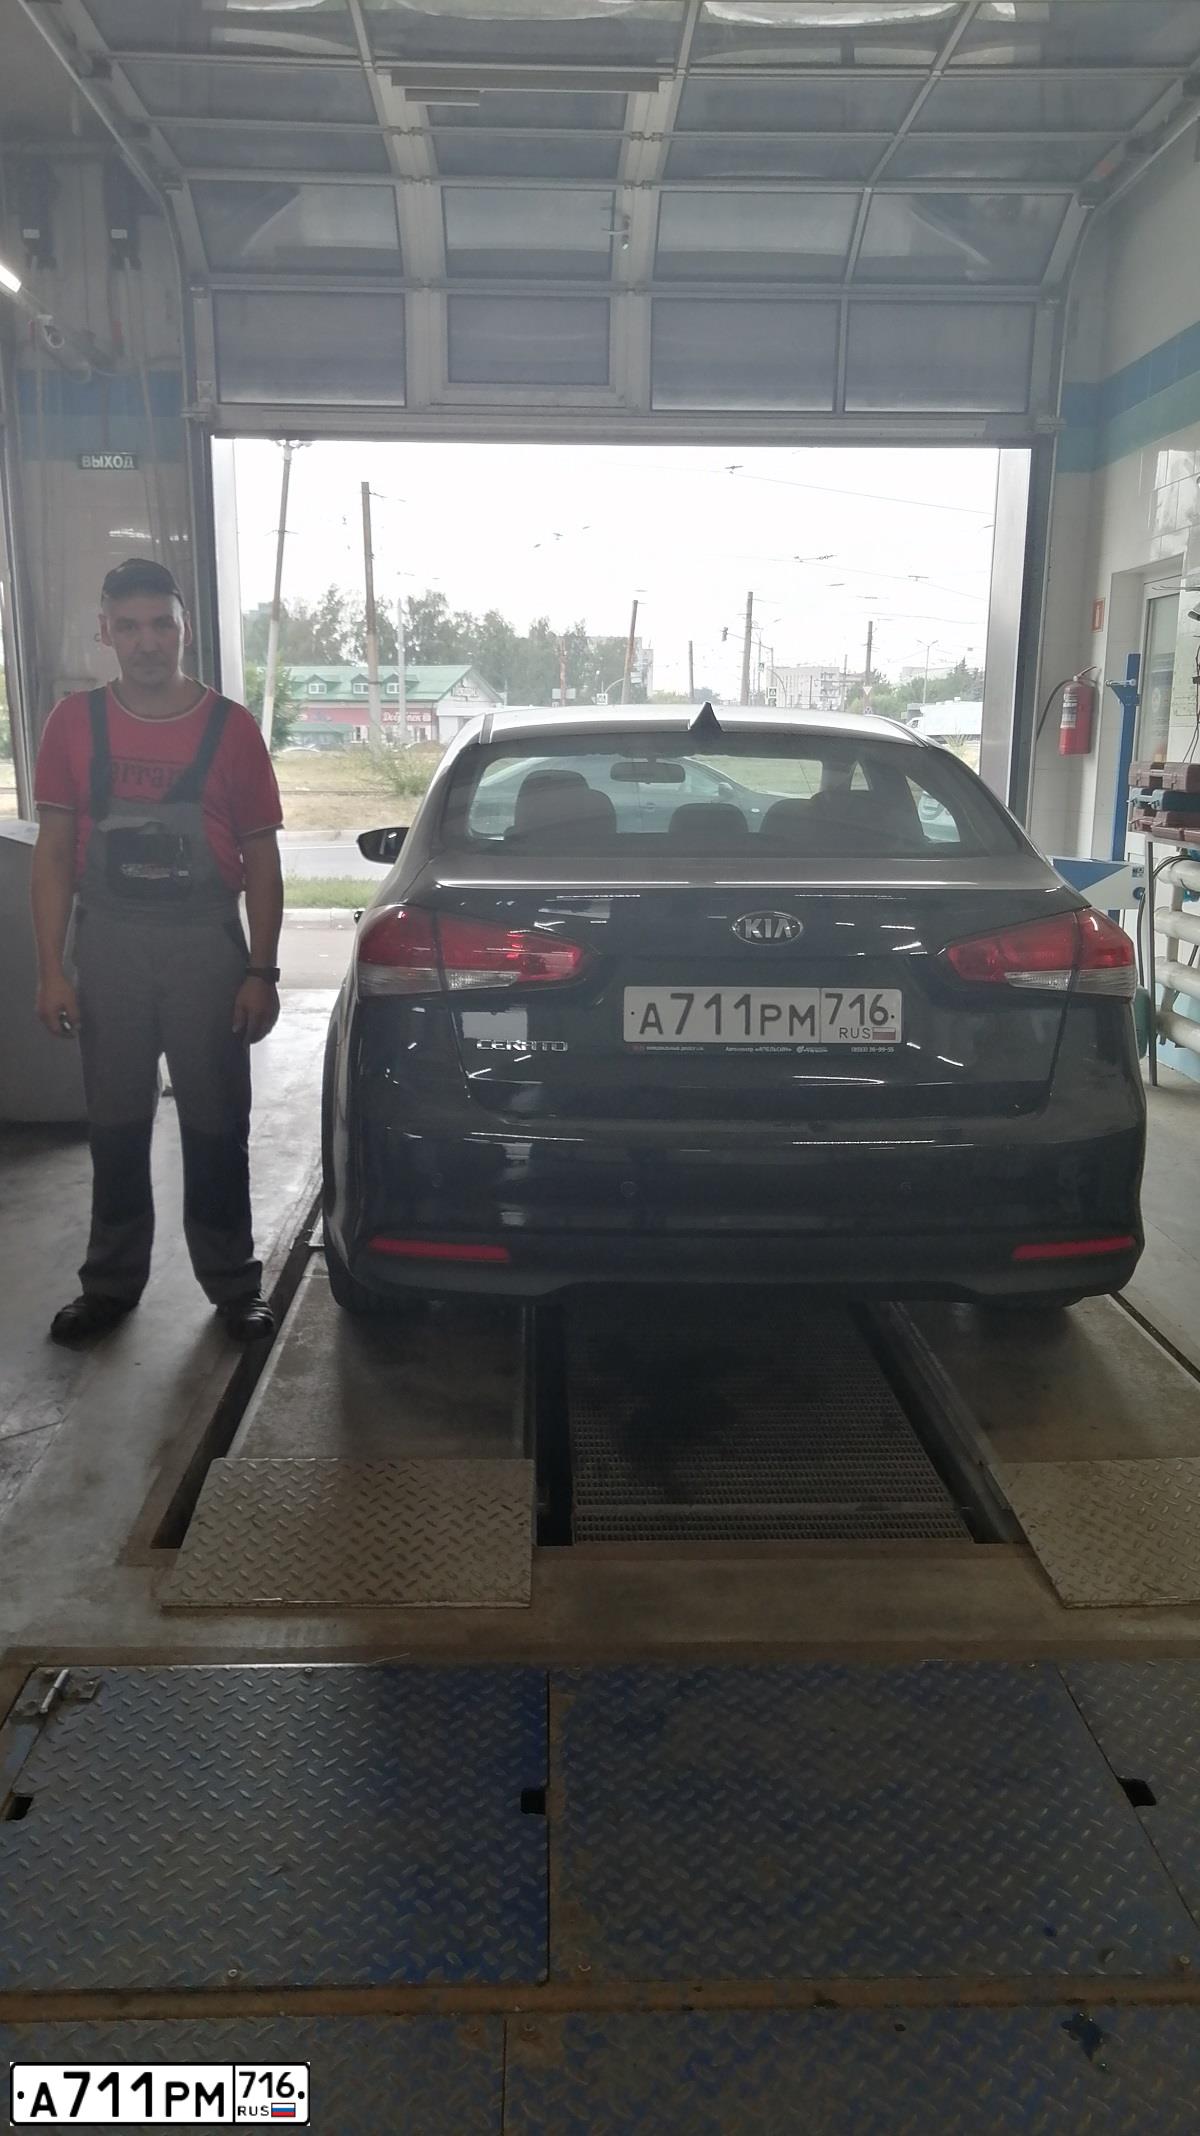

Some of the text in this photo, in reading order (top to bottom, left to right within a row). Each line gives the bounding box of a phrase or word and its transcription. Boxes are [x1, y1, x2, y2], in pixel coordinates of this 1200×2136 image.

[82, 455, 135, 469] ВЫХОД
[745, 918, 792, 938] KIA
[639, 993, 889, 1036] А711РМ 716
[839, 1027, 871, 1039] RUS
